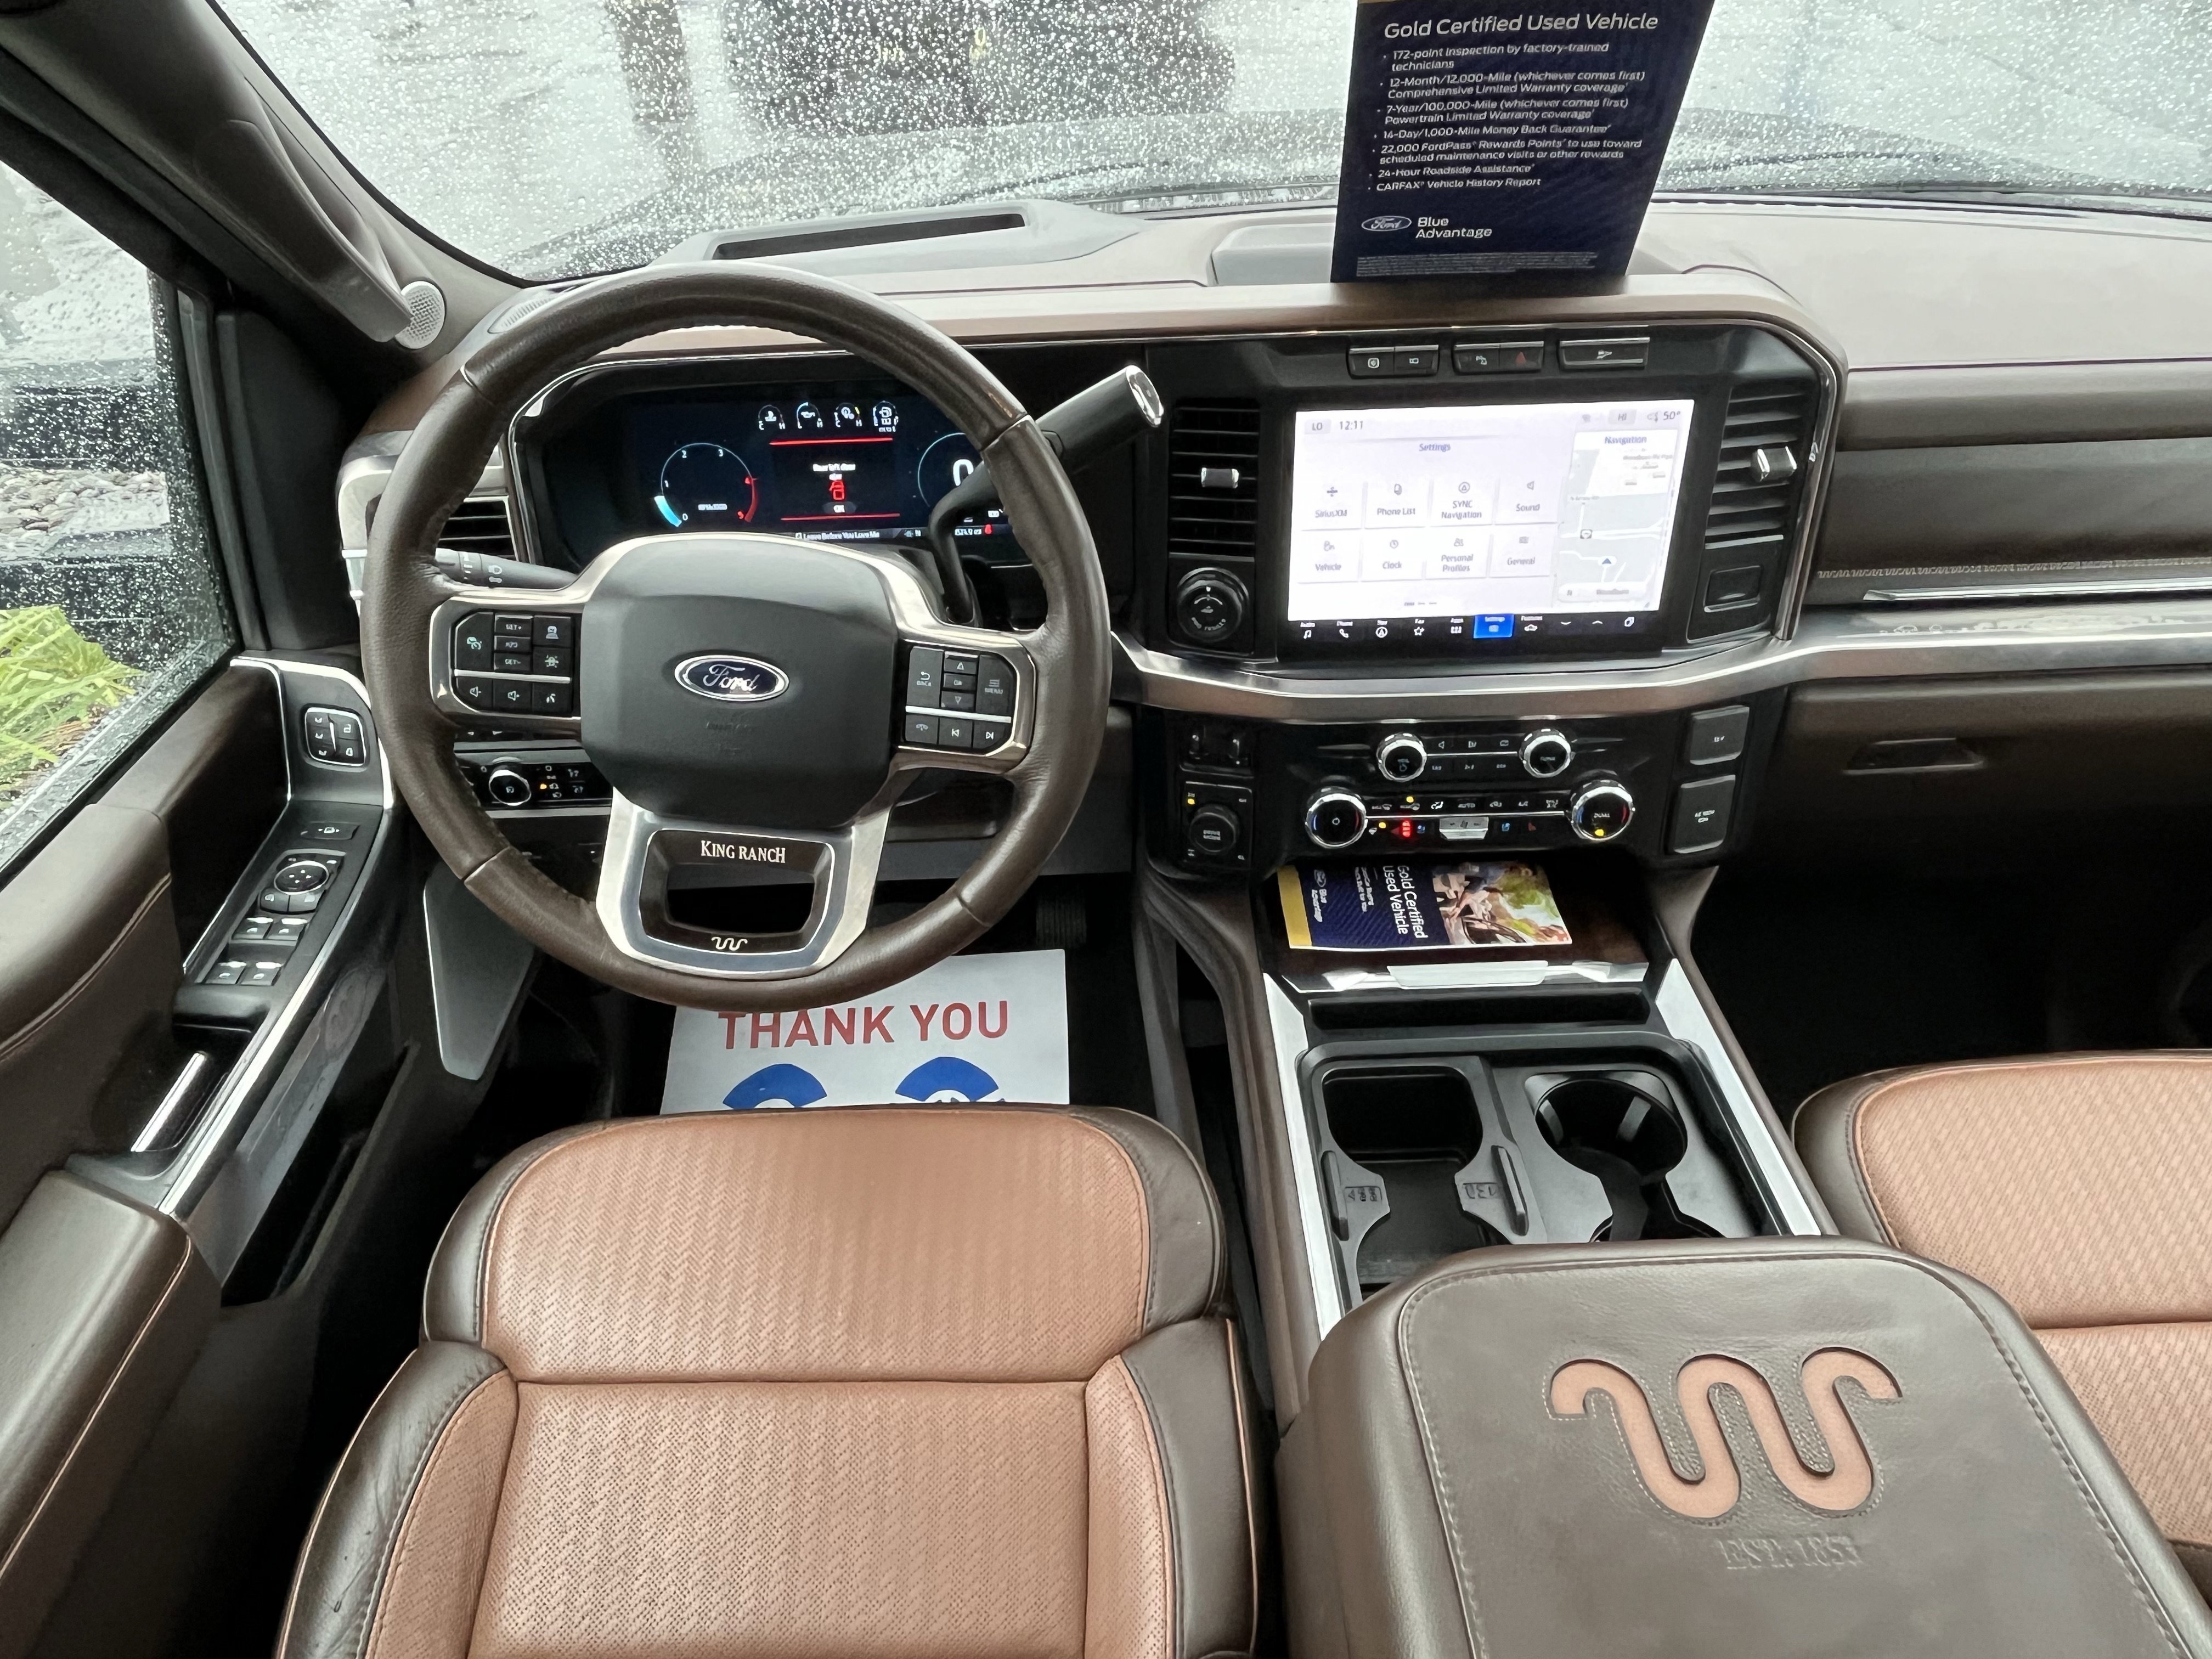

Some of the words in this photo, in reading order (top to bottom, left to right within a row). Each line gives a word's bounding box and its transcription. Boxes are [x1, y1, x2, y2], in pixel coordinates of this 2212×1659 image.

[1384, 20, 1431, 38] Gold
[1436, 14, 1523, 35] Certified
[1527, 13, 1580, 30] Used
[1586, 13, 1658, 30] Vehicle
[1393, 47, 1443, 60] 172-point
[1507, 43, 1521, 55] by
[1523, 42, 1610, 54] factory-trained
[1392, 60, 1454, 71] technicians
[1514, 71, 1576, 82] (whichever
[1577, 72, 1616, 81] comes
[1618, 71, 1645, 81] first)
[1388, 86, 1474, 99] Comprehensive
[1476, 84, 1517, 94] Limited
[1520, 83, 1572, 94] Warranty
[1500, 99, 1560, 109] (whichever
[1562, 99, 1600, 108] comes
[1602, 98, 1628, 109] first)
[1385, 114, 1443, 125] Powertrain
[1446, 111, 1487, 121] Limited
[1489, 111, 1539, 121] Warranty
[1482, 126, 1519, 136] Money
[1521, 125, 1547, 134] Back
[1381, 144, 1419, 155] 22,000
[1479, 140, 1525, 149] Rewards
[1568, 139, 1579, 148] to
[1603, 139, 1643, 148] toward
[1380, 153, 1434, 165] scheduled
[1436, 151, 1504, 161] maintenance
[1507, 150, 1534, 160] visits
[1549, 150, 1579, 159] other
[1378, 168, 1420, 178] 24-Hour
[1423, 165, 1471, 176] Roadside
[1427, 180, 1464, 188] Vehicle
[1466, 178, 1504, 188] History
[1505, 177, 1541, 187] Report
[1418, 217, 1449, 227] Blue
[1415, 228, 1492, 239] Advantage
[1339, 420, 1363, 431] 12:11
[1605, 436, 1647, 445] Navigation
[1419, 443, 1451, 452] Settings
[1452, 500, 1473, 509] SYNC
[1516, 504, 1540, 512] Sound
[1376, 508, 1401, 516] Phone
[1441, 511, 1482, 520] Navigation
[1441, 555, 1474, 563] Personal
[1508, 557, 1536, 566] General
[1315, 563, 1342, 572] Vehicle
[1383, 561, 1402, 569] Clock
[703, 664, 760, 691] Ford
[701, 840, 735, 859] KING
[738, 845, 786, 864] RANCH
[1383, 865, 1401, 892] Used
[1398, 865, 1415, 889] Gold
[1390, 894, 1410, 935] Vehicle
[1404, 890, 1429, 939] Certified
[718, 1006, 895, 1049] THANK
[910, 1001, 1008, 1041] YOU
